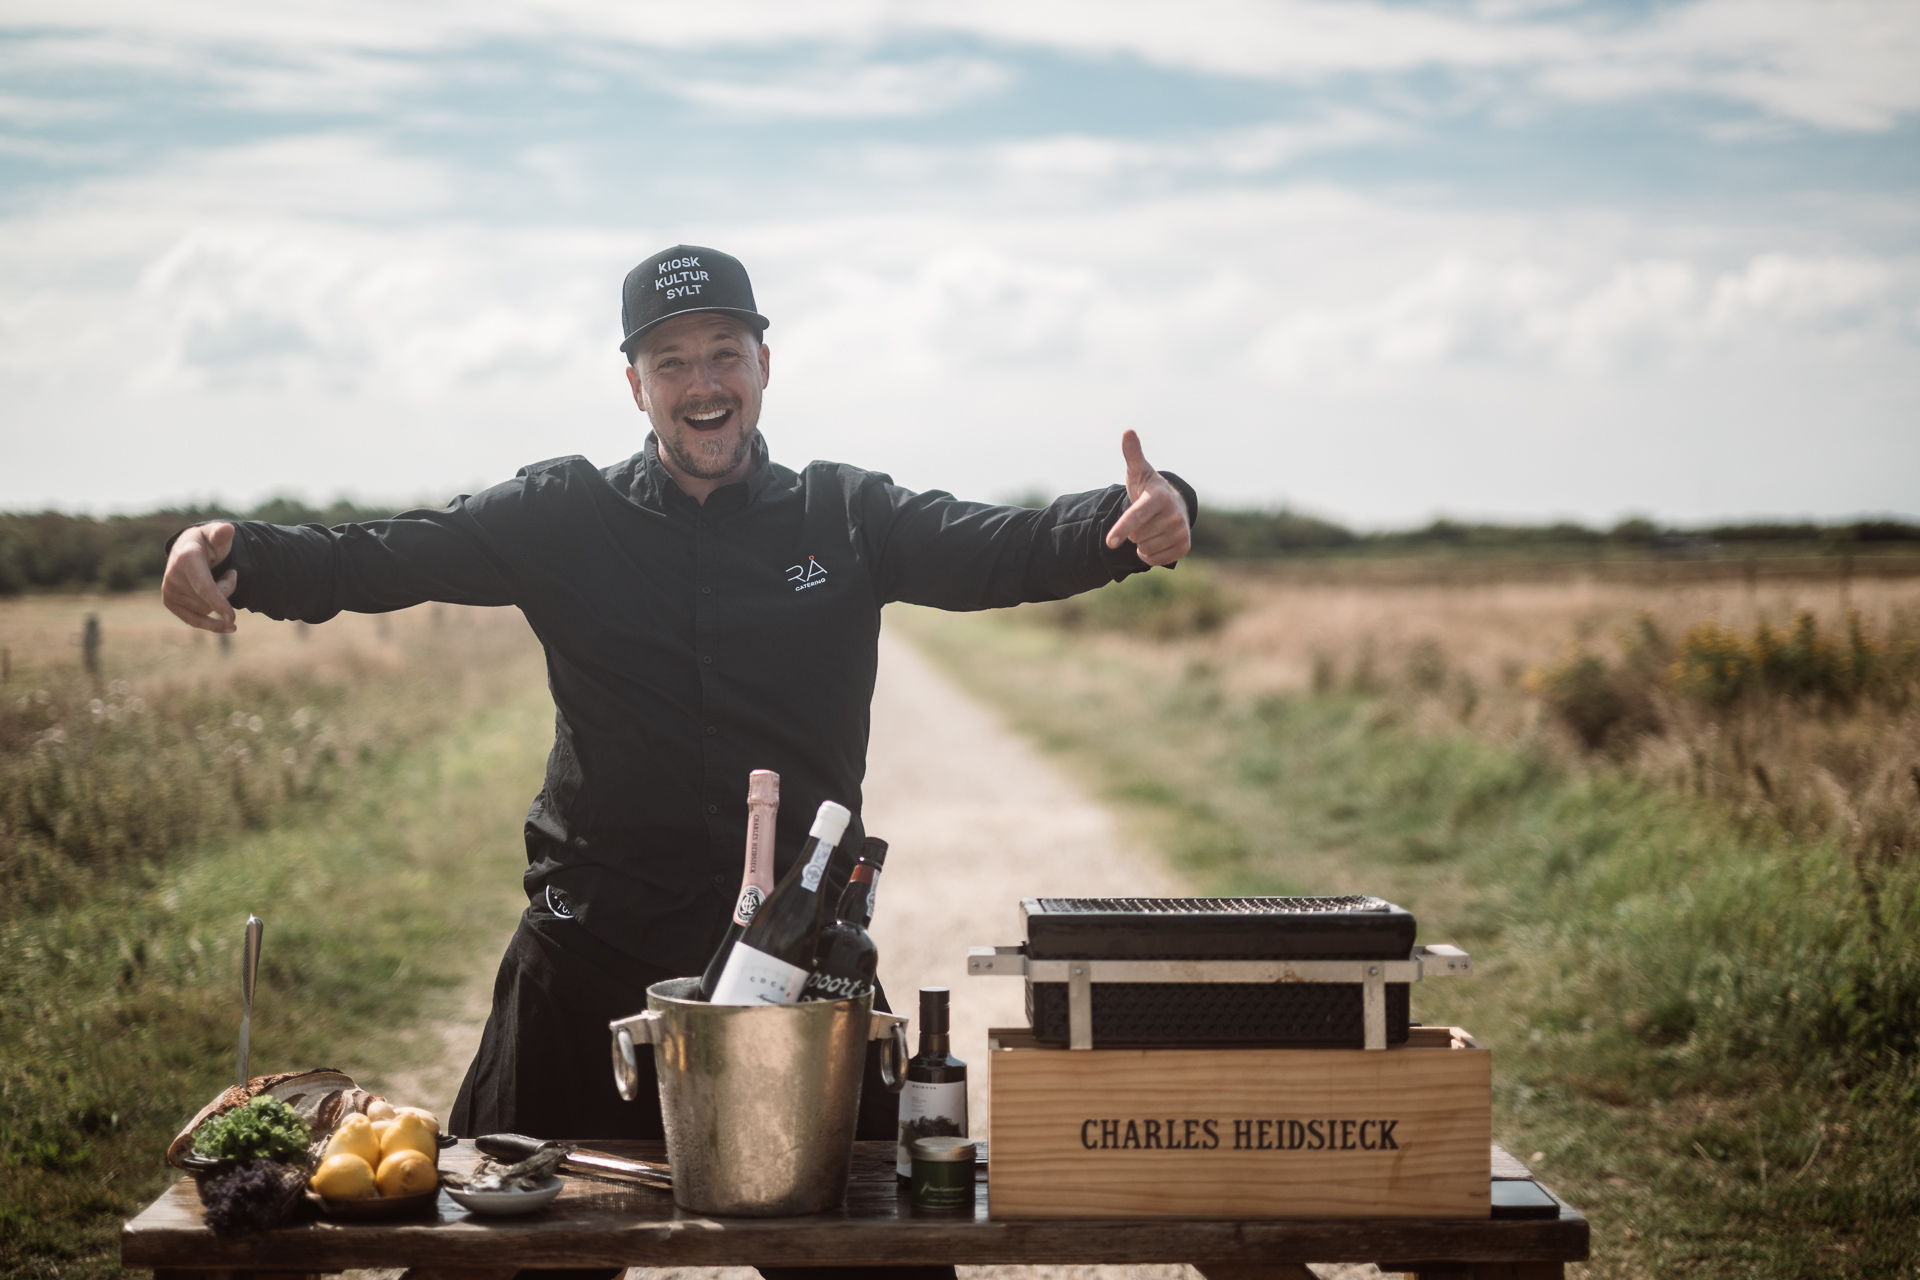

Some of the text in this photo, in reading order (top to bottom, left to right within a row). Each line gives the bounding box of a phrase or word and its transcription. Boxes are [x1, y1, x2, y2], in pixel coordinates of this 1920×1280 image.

[658, 256, 701, 275] KIOSK
[655, 270, 710, 291] KULTUR
[666, 284, 702, 300] SYLT
[795, 577, 826, 592] CATERING
[749, 814, 760, 874] CHARLES HEIDSIECK
[802, 970, 862, 1000] poort
[1080, 1118, 1400, 1150] CHARLES HEIDSIECK
